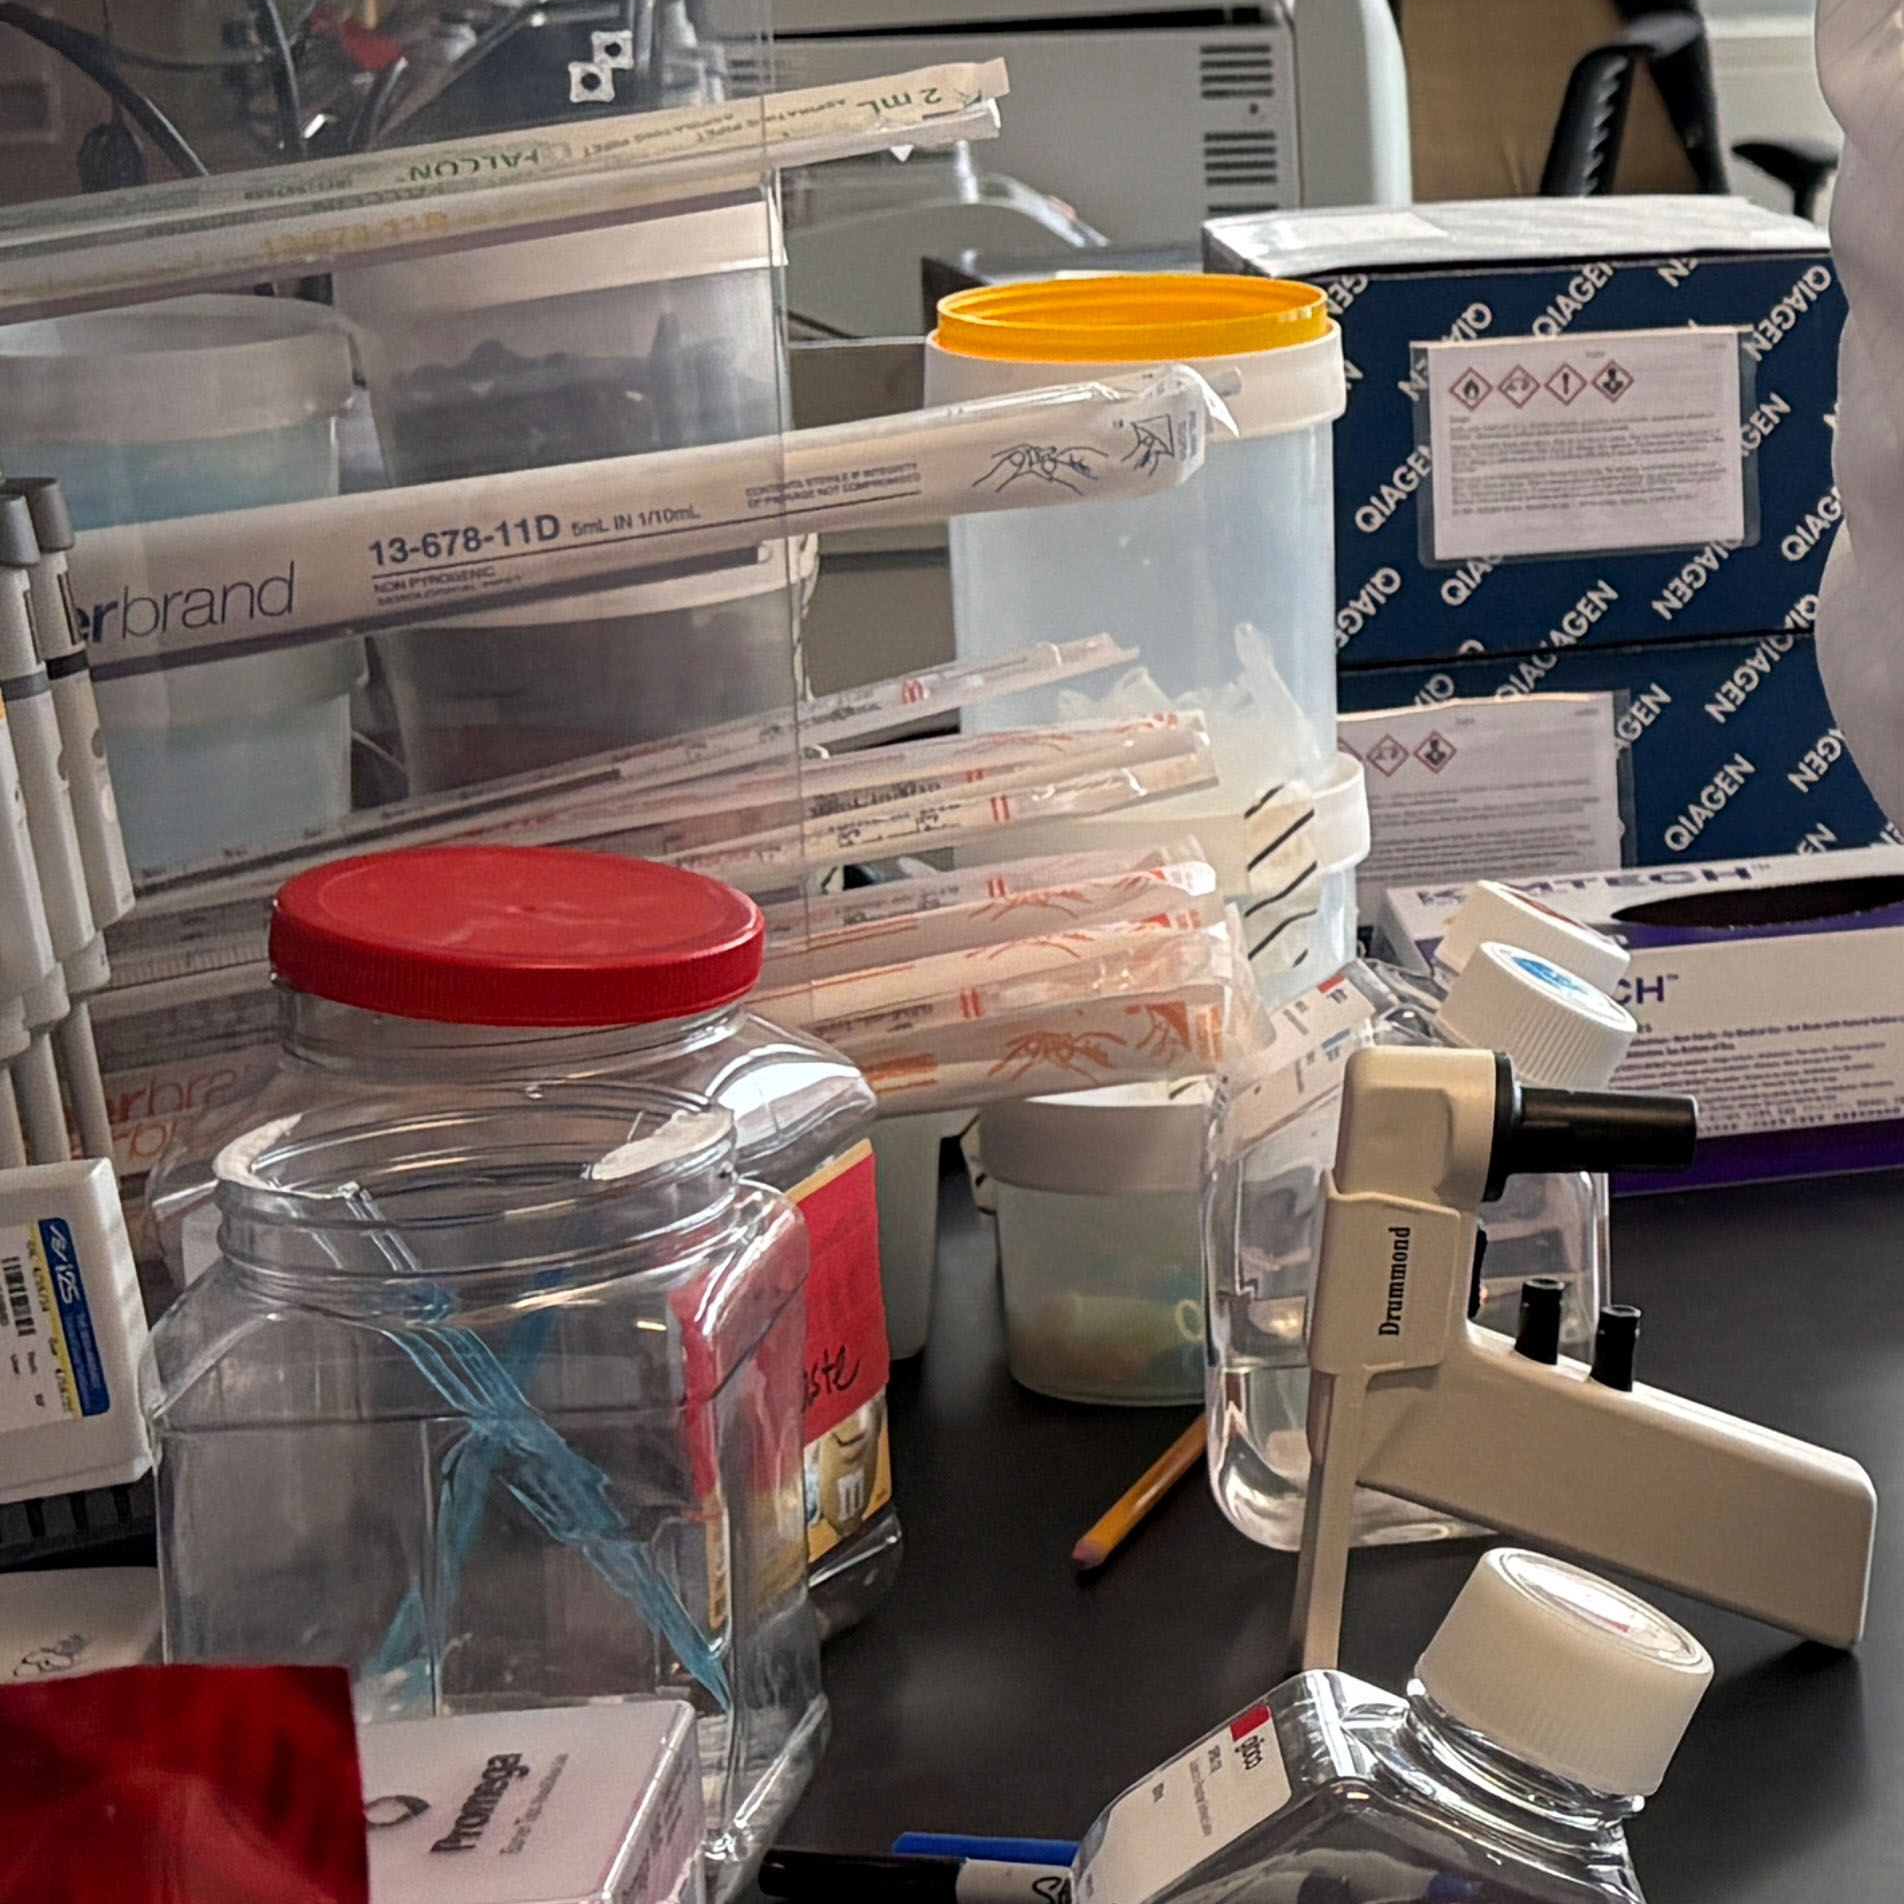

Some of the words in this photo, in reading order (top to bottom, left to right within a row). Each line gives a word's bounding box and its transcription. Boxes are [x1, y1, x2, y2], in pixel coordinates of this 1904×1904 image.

[924, 87, 942, 105] 2
[1742, 265, 1831, 361] QIAGEN
[369, 514, 561, 567] 13-678-11D
[613, 514, 633, 532] IN
[1664, 753, 1756, 852] QIAGEN
[1378, 1227, 1411, 1336] Drummond
[430, 1752, 530, 1853] Promega
